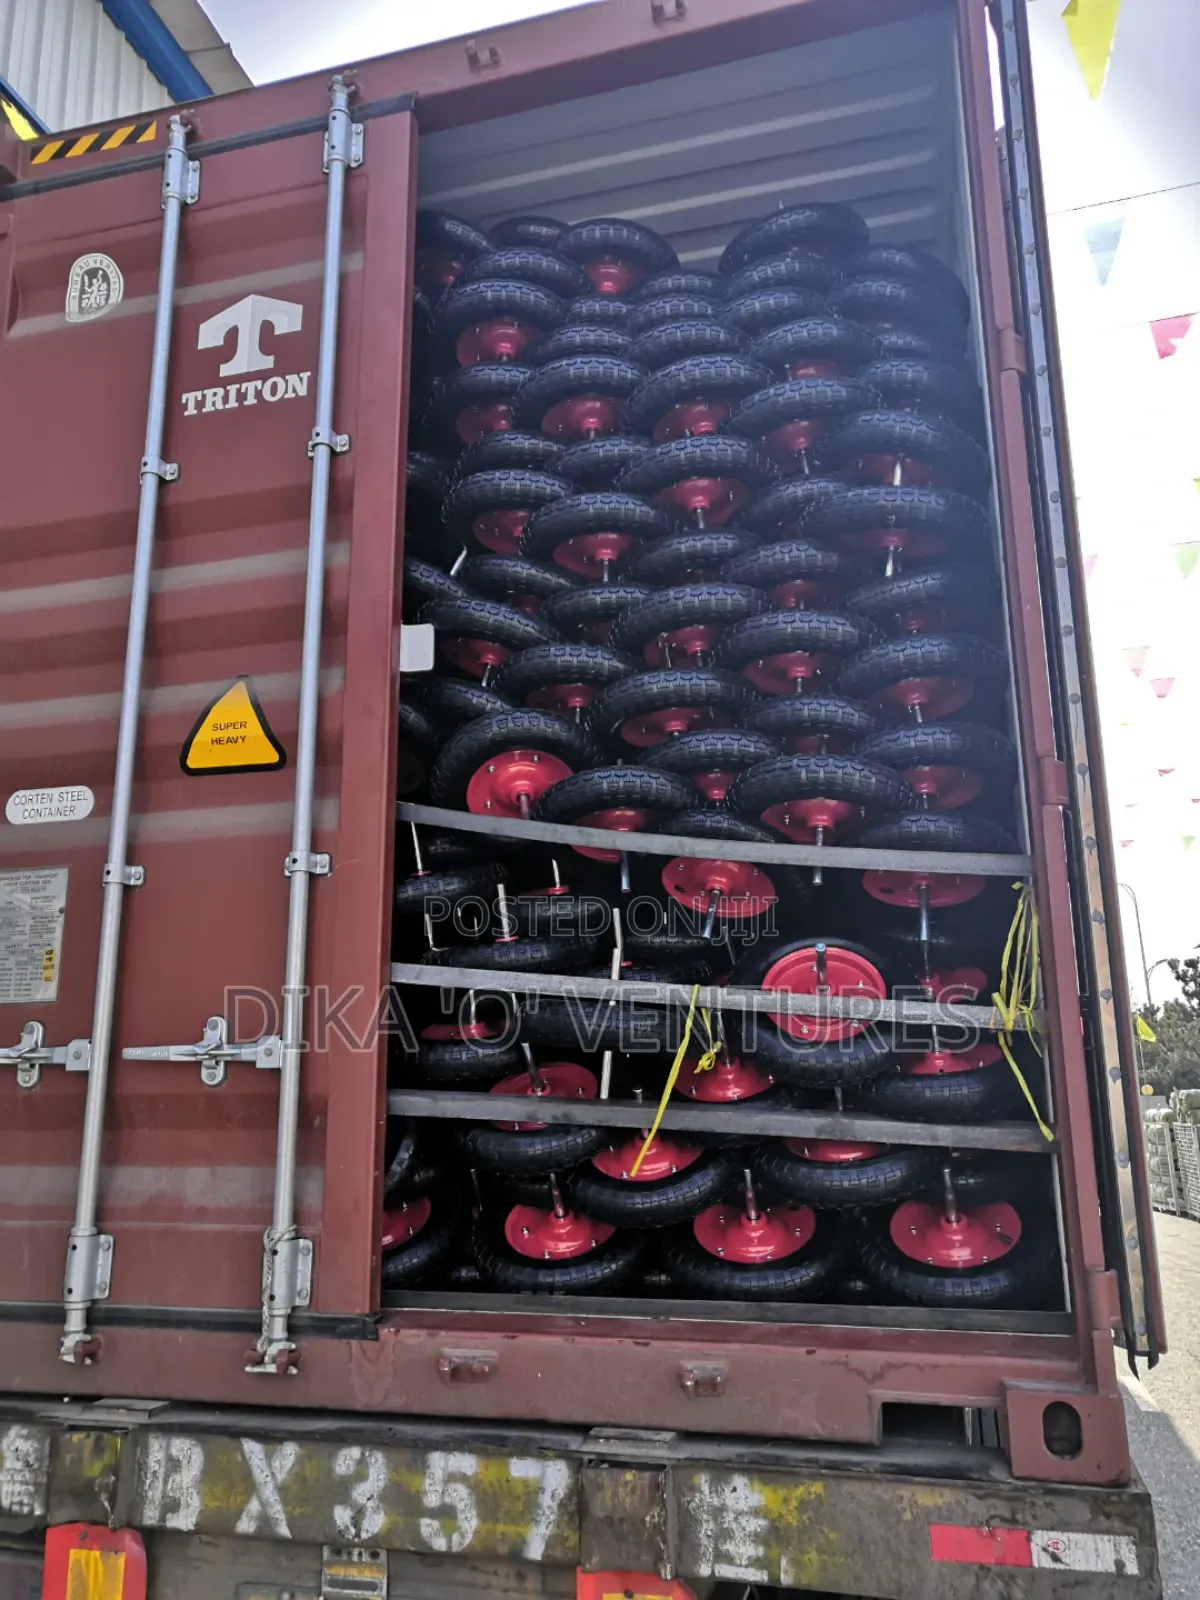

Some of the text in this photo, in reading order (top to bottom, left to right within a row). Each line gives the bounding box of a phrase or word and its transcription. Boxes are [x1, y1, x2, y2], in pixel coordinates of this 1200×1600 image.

[71, 259, 90, 300] BUREAU
[181, 371, 312, 417] TRITON
[211, 720, 248, 732] SUPER
[210, 734, 247, 746] HEAVY
[13, 789, 89, 807] CORTEN STEEL
[22, 805, 76, 820] CONTAINER
